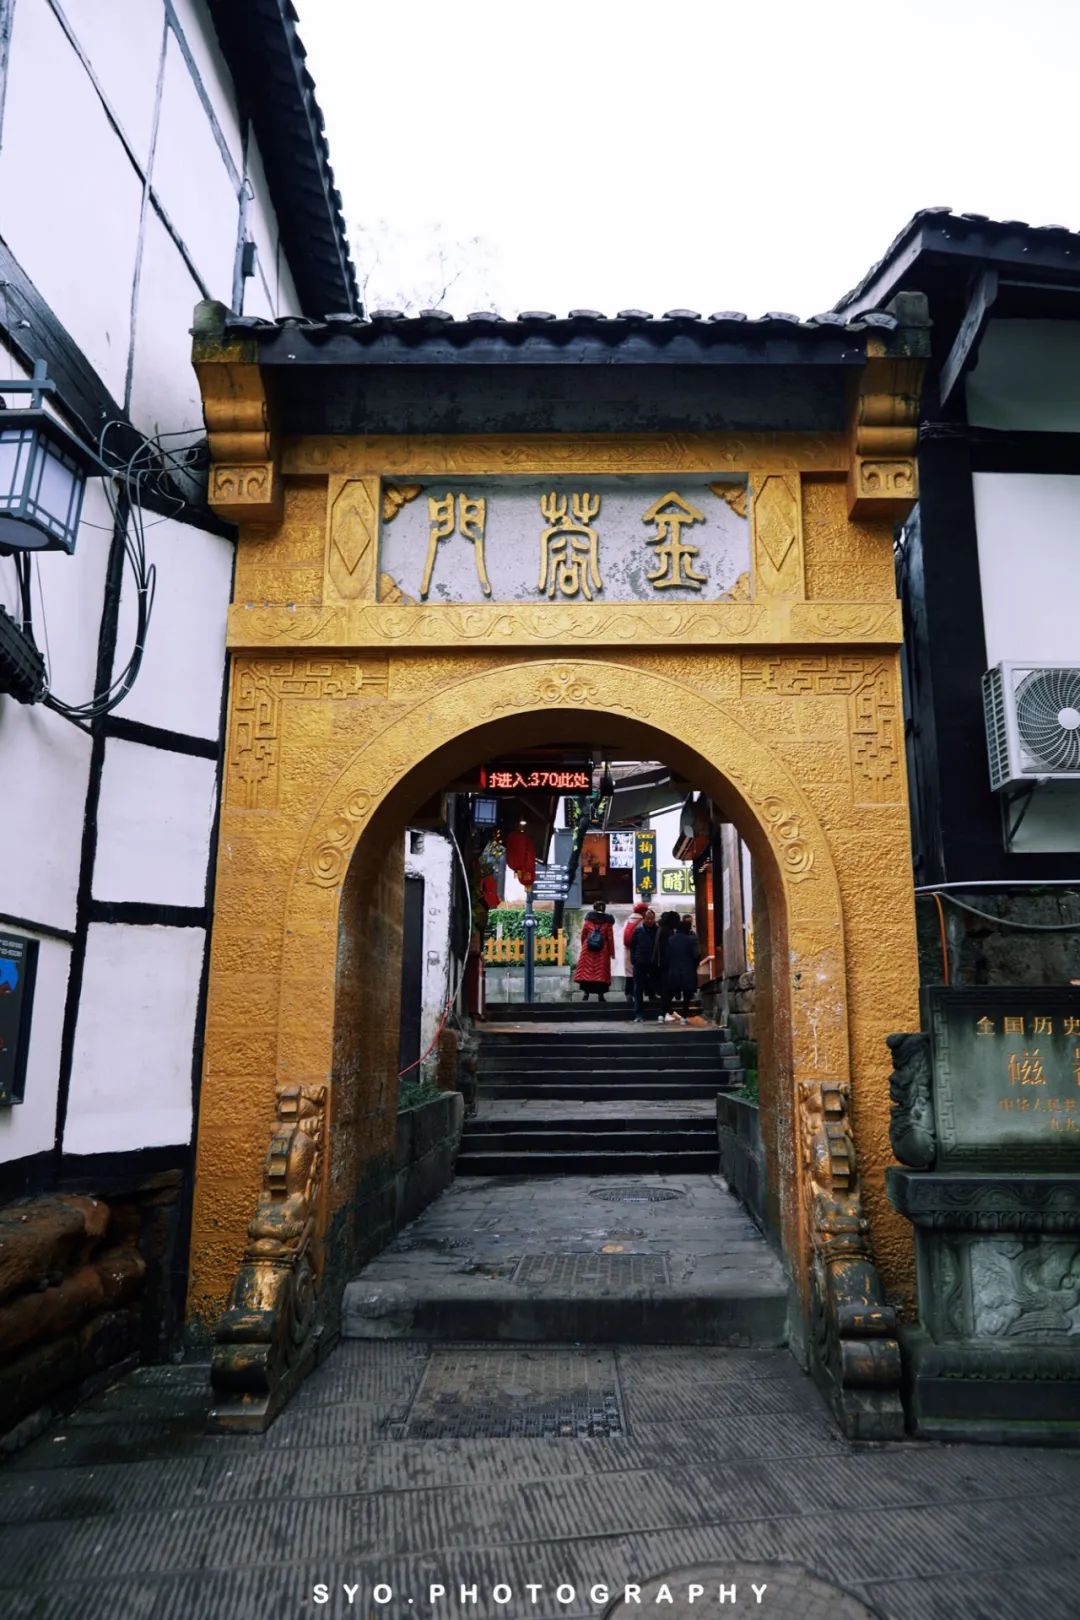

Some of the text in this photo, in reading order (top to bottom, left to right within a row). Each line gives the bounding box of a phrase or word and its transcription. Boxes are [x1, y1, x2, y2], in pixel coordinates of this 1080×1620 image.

[639, 841, 653, 890] 掏耳朵
[976, 1015, 1080, 1036] 全国历史
